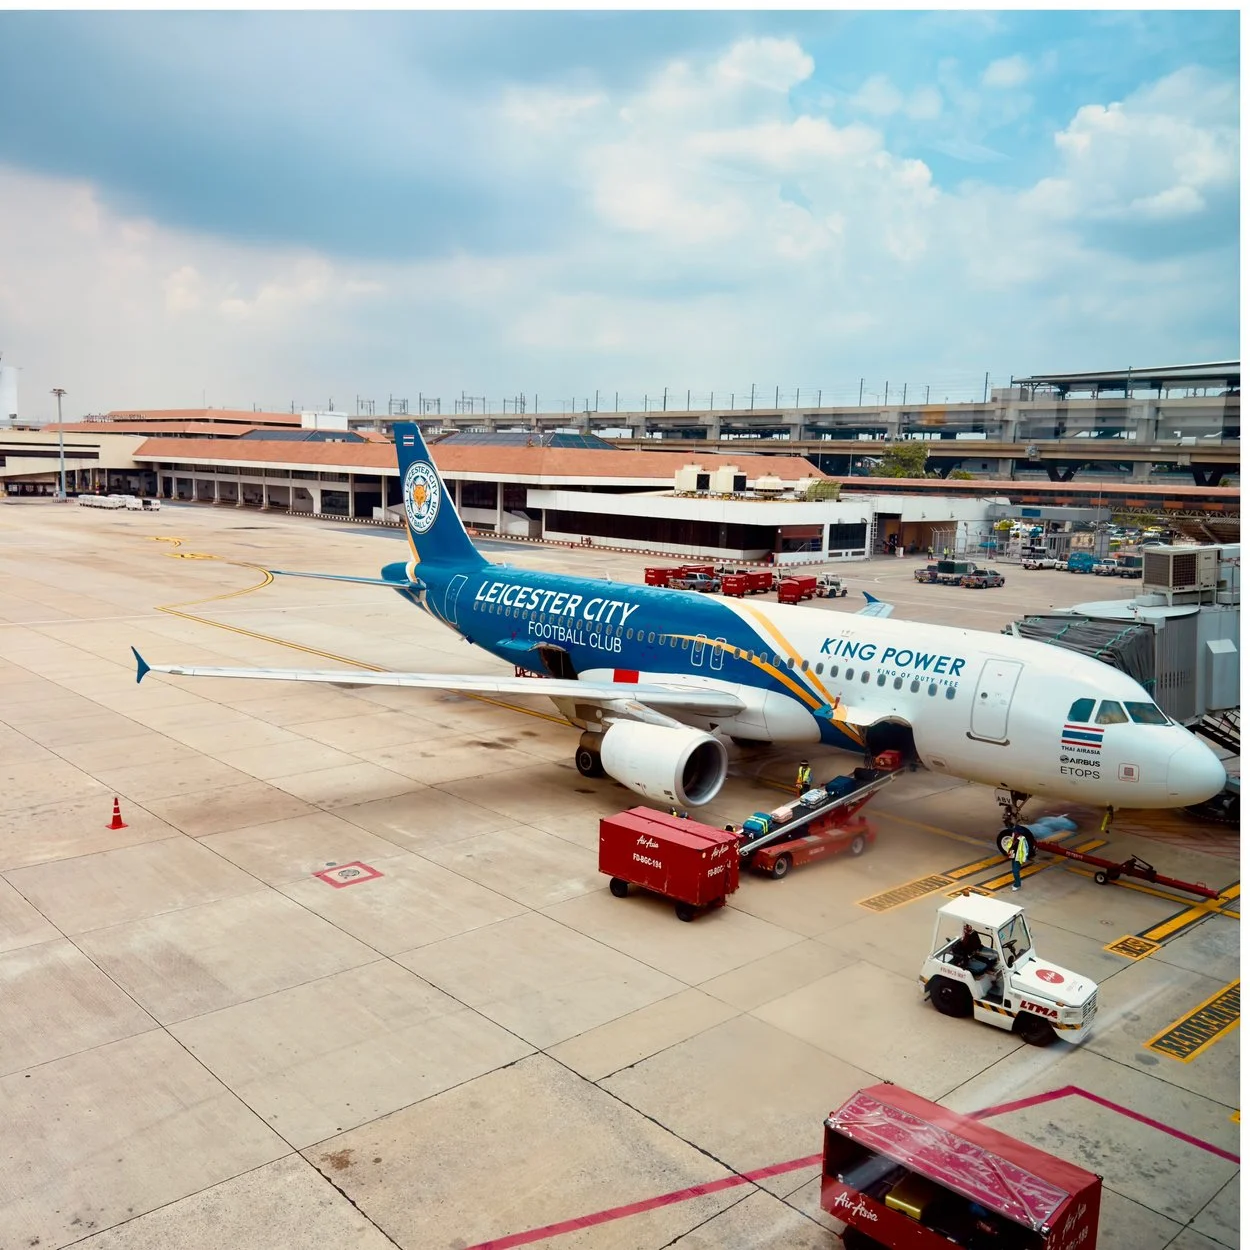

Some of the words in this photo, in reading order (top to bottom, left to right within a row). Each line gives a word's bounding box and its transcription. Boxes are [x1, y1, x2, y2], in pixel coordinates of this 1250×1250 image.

[475, 580, 583, 618] LEICESTER
[583, 598, 640, 626] CITY
[528, 621, 586, 646] FOOTBALL
[589, 632, 622, 653] CLUB
[820, 637, 877, 661] KING
[881, 647, 966, 677] POWER
[877, 668, 896, 677] KING
[915, 674, 936, 683] DUTY
[939, 678, 959, 688] FREE
[1076, 748, 1101, 756] AIRASIA
[1060, 765, 1101, 780] ETOPS
[1070, 757, 1101, 768] AIRBUS
[997, 795, 1011, 804] ABV
[1019, 999, 1059, 1019] LTMA
